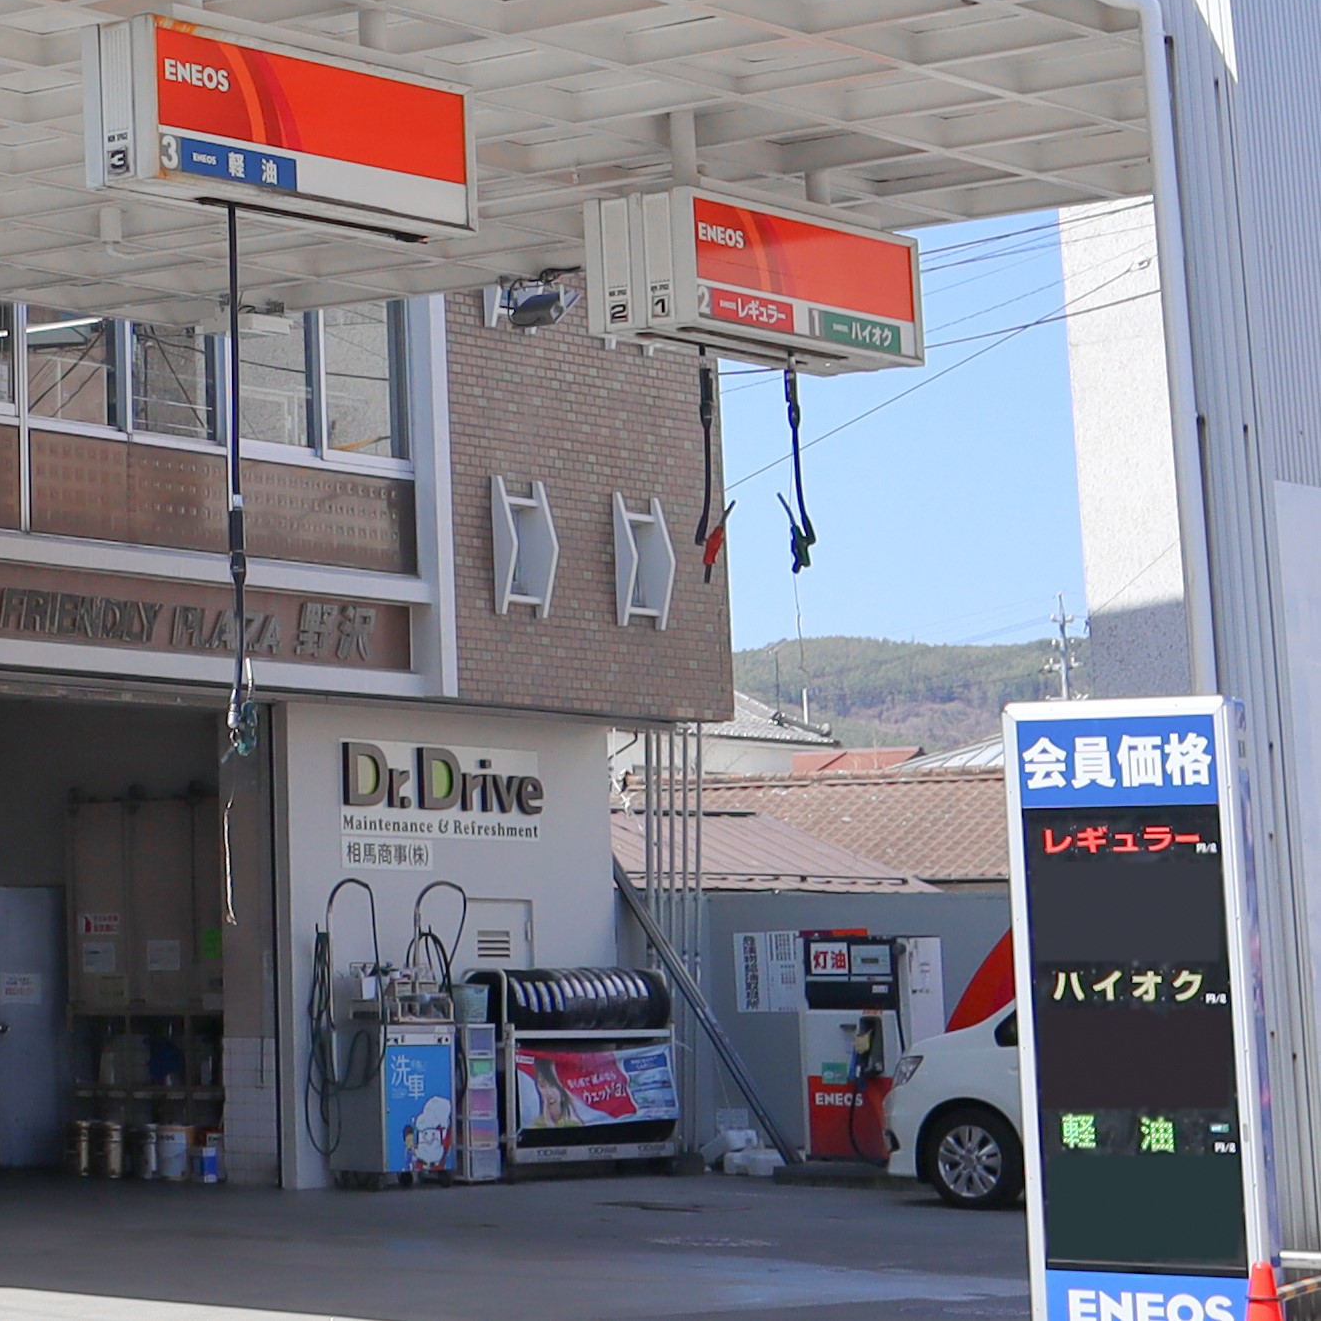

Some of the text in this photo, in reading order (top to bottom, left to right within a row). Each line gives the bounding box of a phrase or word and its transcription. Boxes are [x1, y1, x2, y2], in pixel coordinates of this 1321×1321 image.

[164, 58, 229, 92] ENEOS
[110, 150, 125, 170] 3
[161, 136, 179, 170] 3
[192, 151, 278, 186] ENEOS 軽油
[698, 221, 745, 249] ENEOS
[610, 303, 627, 320] 2
[653, 297, 666, 314] 1
[698, 290, 709, 314] 2
[737, 297, 787, 324] レギュラー
[813, 309, 821, 336] 1
[851, 321, 893, 347] ハイオク
[170, 603, 282, 654] PLAZA
[294, 601, 377, 662] 野沢
[1022, 732, 1212, 790] 会員価格
[342, 741, 544, 815] Dr.Drive
[342, 814, 539, 839] Maintenance & Refreshment
[1043, 826, 1201, 854] レギュラー
[347, 841, 430, 866] 相馬商事(株)
[813, 950, 846, 971] 灯油
[1052, 969, 1203, 1002] ハイオク
[390, 1054, 426, 1101] 洗車
[815, 1092, 864, 1106] ENEOS
[1061, 1113, 1177, 1154] 軽油
[1066, 1288, 1235, 1321] ENEOS
